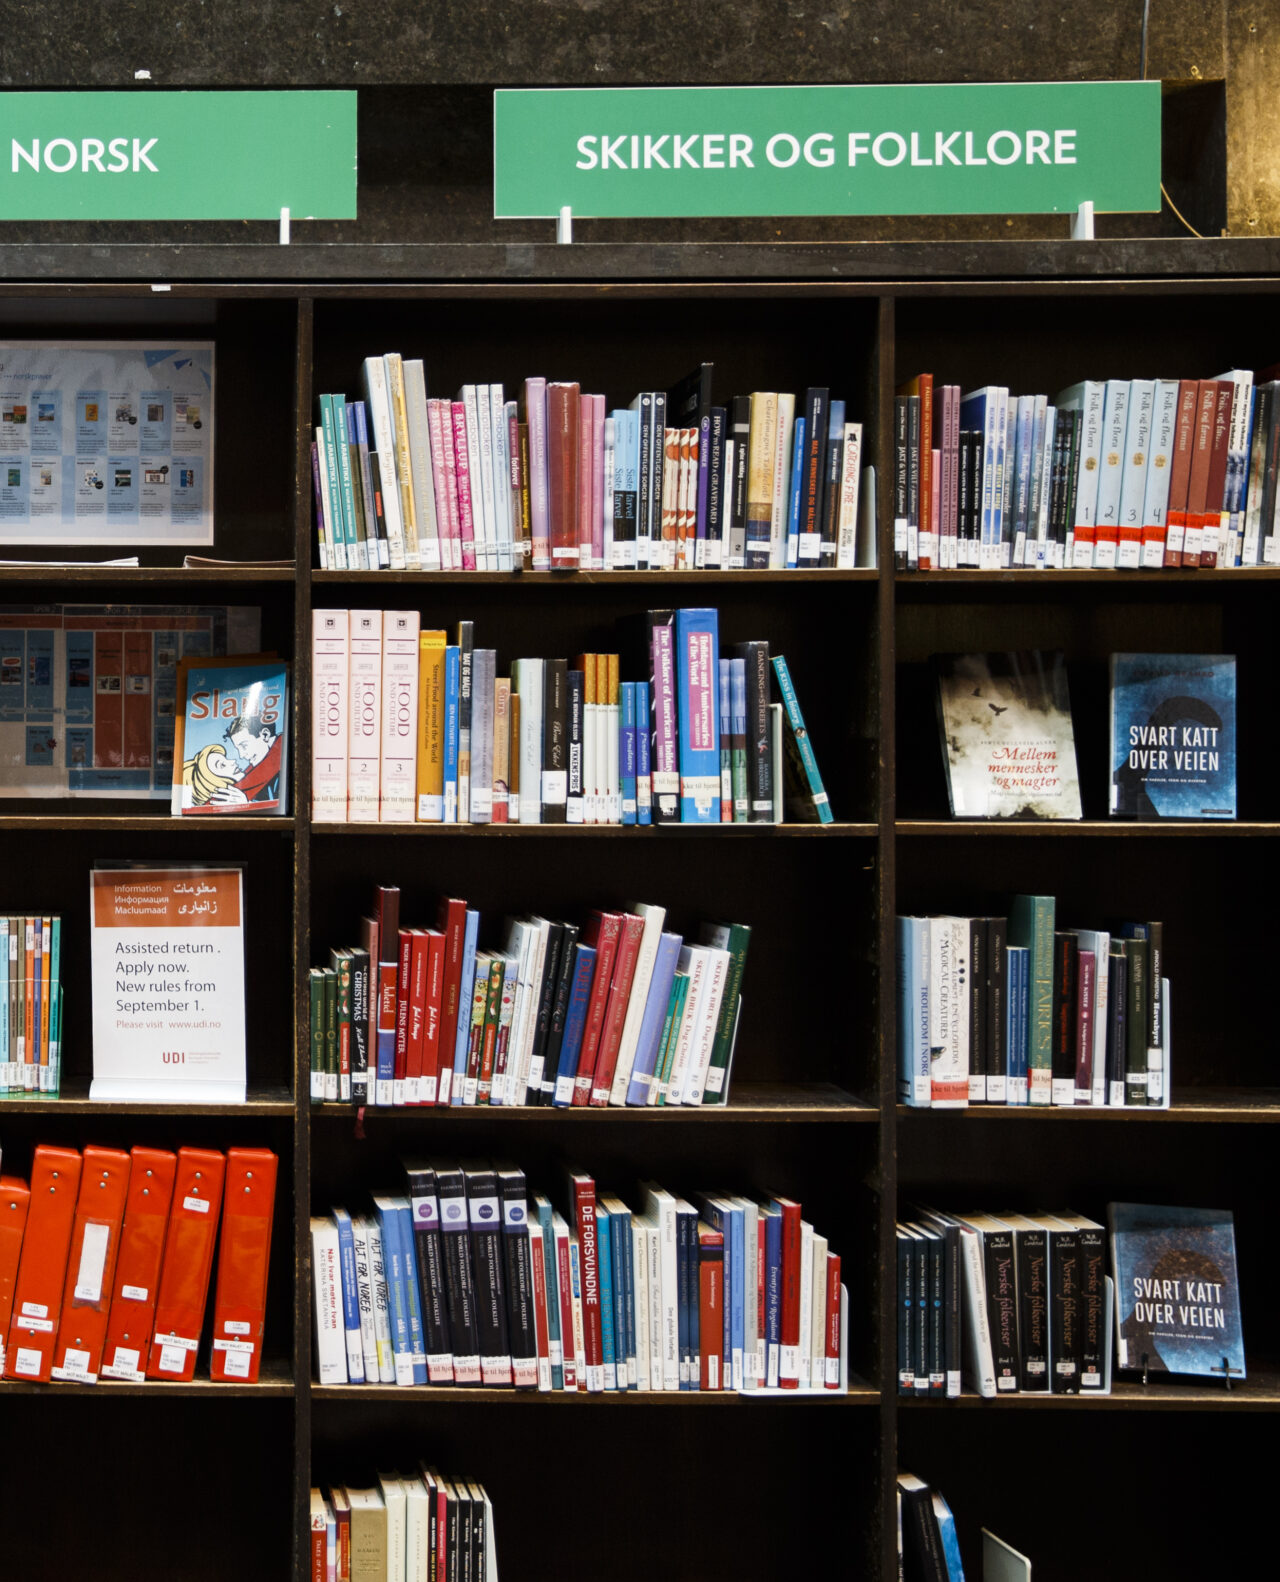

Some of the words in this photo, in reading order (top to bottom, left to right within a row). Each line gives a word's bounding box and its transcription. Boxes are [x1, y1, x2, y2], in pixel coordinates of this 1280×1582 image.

[12, 138, 159, 173] NORSK
[576, 134, 754, 169] SKIKKER
[766, 133, 835, 168] OG
[848, 130, 1077, 167] FOLKLORE
[1090, 392, 1100, 411] Folk
[1115, 392, 1125, 411] Folk
[1184, 391, 1193, 410] Folk
[1088, 413, 1097, 424] og
[1113, 413, 1121, 424] og
[431, 411, 443, 467] BRYLLUP
[441, 412, 453, 468] BRYLLUP
[455, 414, 466, 469] BRYLLUP
[1087, 426, 1096, 448] flora
[1112, 427, 1121, 447] flora
[511, 457, 519, 485] forlover
[615, 468, 623, 489] Siste
[626, 469, 634, 489] Siste
[614, 494, 623, 519] farvel
[626, 494, 634, 519] farvel
[1128, 509, 1136, 521] 3
[661, 629, 670, 646] The
[690, 635, 699, 643] of
[690, 644, 698, 655] the
[699, 635, 709, 669] Holidays
[661, 648, 671, 684] Folklore
[689, 656, 699, 685] World
[663, 685, 672, 696] of
[700, 671, 709, 688] and
[780, 673, 791, 692] KISS
[326, 682, 340, 736] FOOD
[362, 682, 375, 736] FOOD
[397, 682, 410, 736] FOOD
[496, 686, 508, 717] Curry
[662, 697, 673, 739] American
[700, 689, 710, 746] Anniversaries
[1129, 726, 1177, 747] SVART
[1182, 727, 1219, 748] KATT
[571, 746, 579, 773] LYKKENS
[992, 747, 1057, 760] Mellem
[1129, 750, 1169, 770] OVER
[1174, 751, 1219, 771] VEIEN
[987, 763, 1059, 774] mennesker
[571, 775, 579, 790] PRIS
[995, 776, 1010, 790] og
[1011, 777, 1060, 789] magter
[114, 896, 169, 905] Информация
[173, 883, 217, 894] معلومات
[114, 906, 167, 914] Macluumaad
[116, 942, 169, 954] Assisted
[172, 944, 214, 954] return
[116, 961, 154, 975] Apply
[158, 963, 189, 974] now.
[692, 959, 702, 986] SKIKK
[940, 939, 950, 983] MAGICAL
[116, 981, 145, 992] New
[149, 980, 181, 992] rules
[184, 980, 216, 992] from
[353, 971, 362, 1021] CHRISTMAS
[382, 983, 395, 1013] Juletid
[116, 999, 189, 1014] September
[195, 1000, 204, 1011] 1.
[686, 996, 696, 1020] BRUK
[940, 985, 949, 1039] CREATURES
[116, 1020, 143, 1029] Please
[146, 1020, 163, 1029] visit
[169, 1020, 221, 1029] www.udi.no
[162, 1052, 185, 1064] UDI
[583, 1206, 594, 1222] DE
[355, 1240, 366, 1258] ALT
[372, 1238, 382, 1256] ALT
[357, 1262, 367, 1278] FOR
[374, 1260, 384, 1277] FOR
[584, 1225, 597, 1305] FORSVUNDNE
[996, 1257, 1011, 1294] Norske
[1028, 1256, 1044, 1293] Norske
[1060, 1257, 1076, 1294] Norske
[1086, 1254, 1101, 1291] Norske
[360, 1282, 371, 1313] NOREG
[375, 1280, 386, 1312] NOREG
[1133, 1277, 1180, 1299] SVART
[1186, 1282, 1222, 1303] KATT
[993, 1295, 1012, 1348] folkeviser
[1024, 1294, 1044, 1347] folkeviser
[1056, 1295, 1076, 1348] folkeviser
[1081, 1292, 1102, 1345] folkeviser
[1135, 1302, 1174, 1325] OVER
[1180, 1305, 1225, 1329] VEIEN
